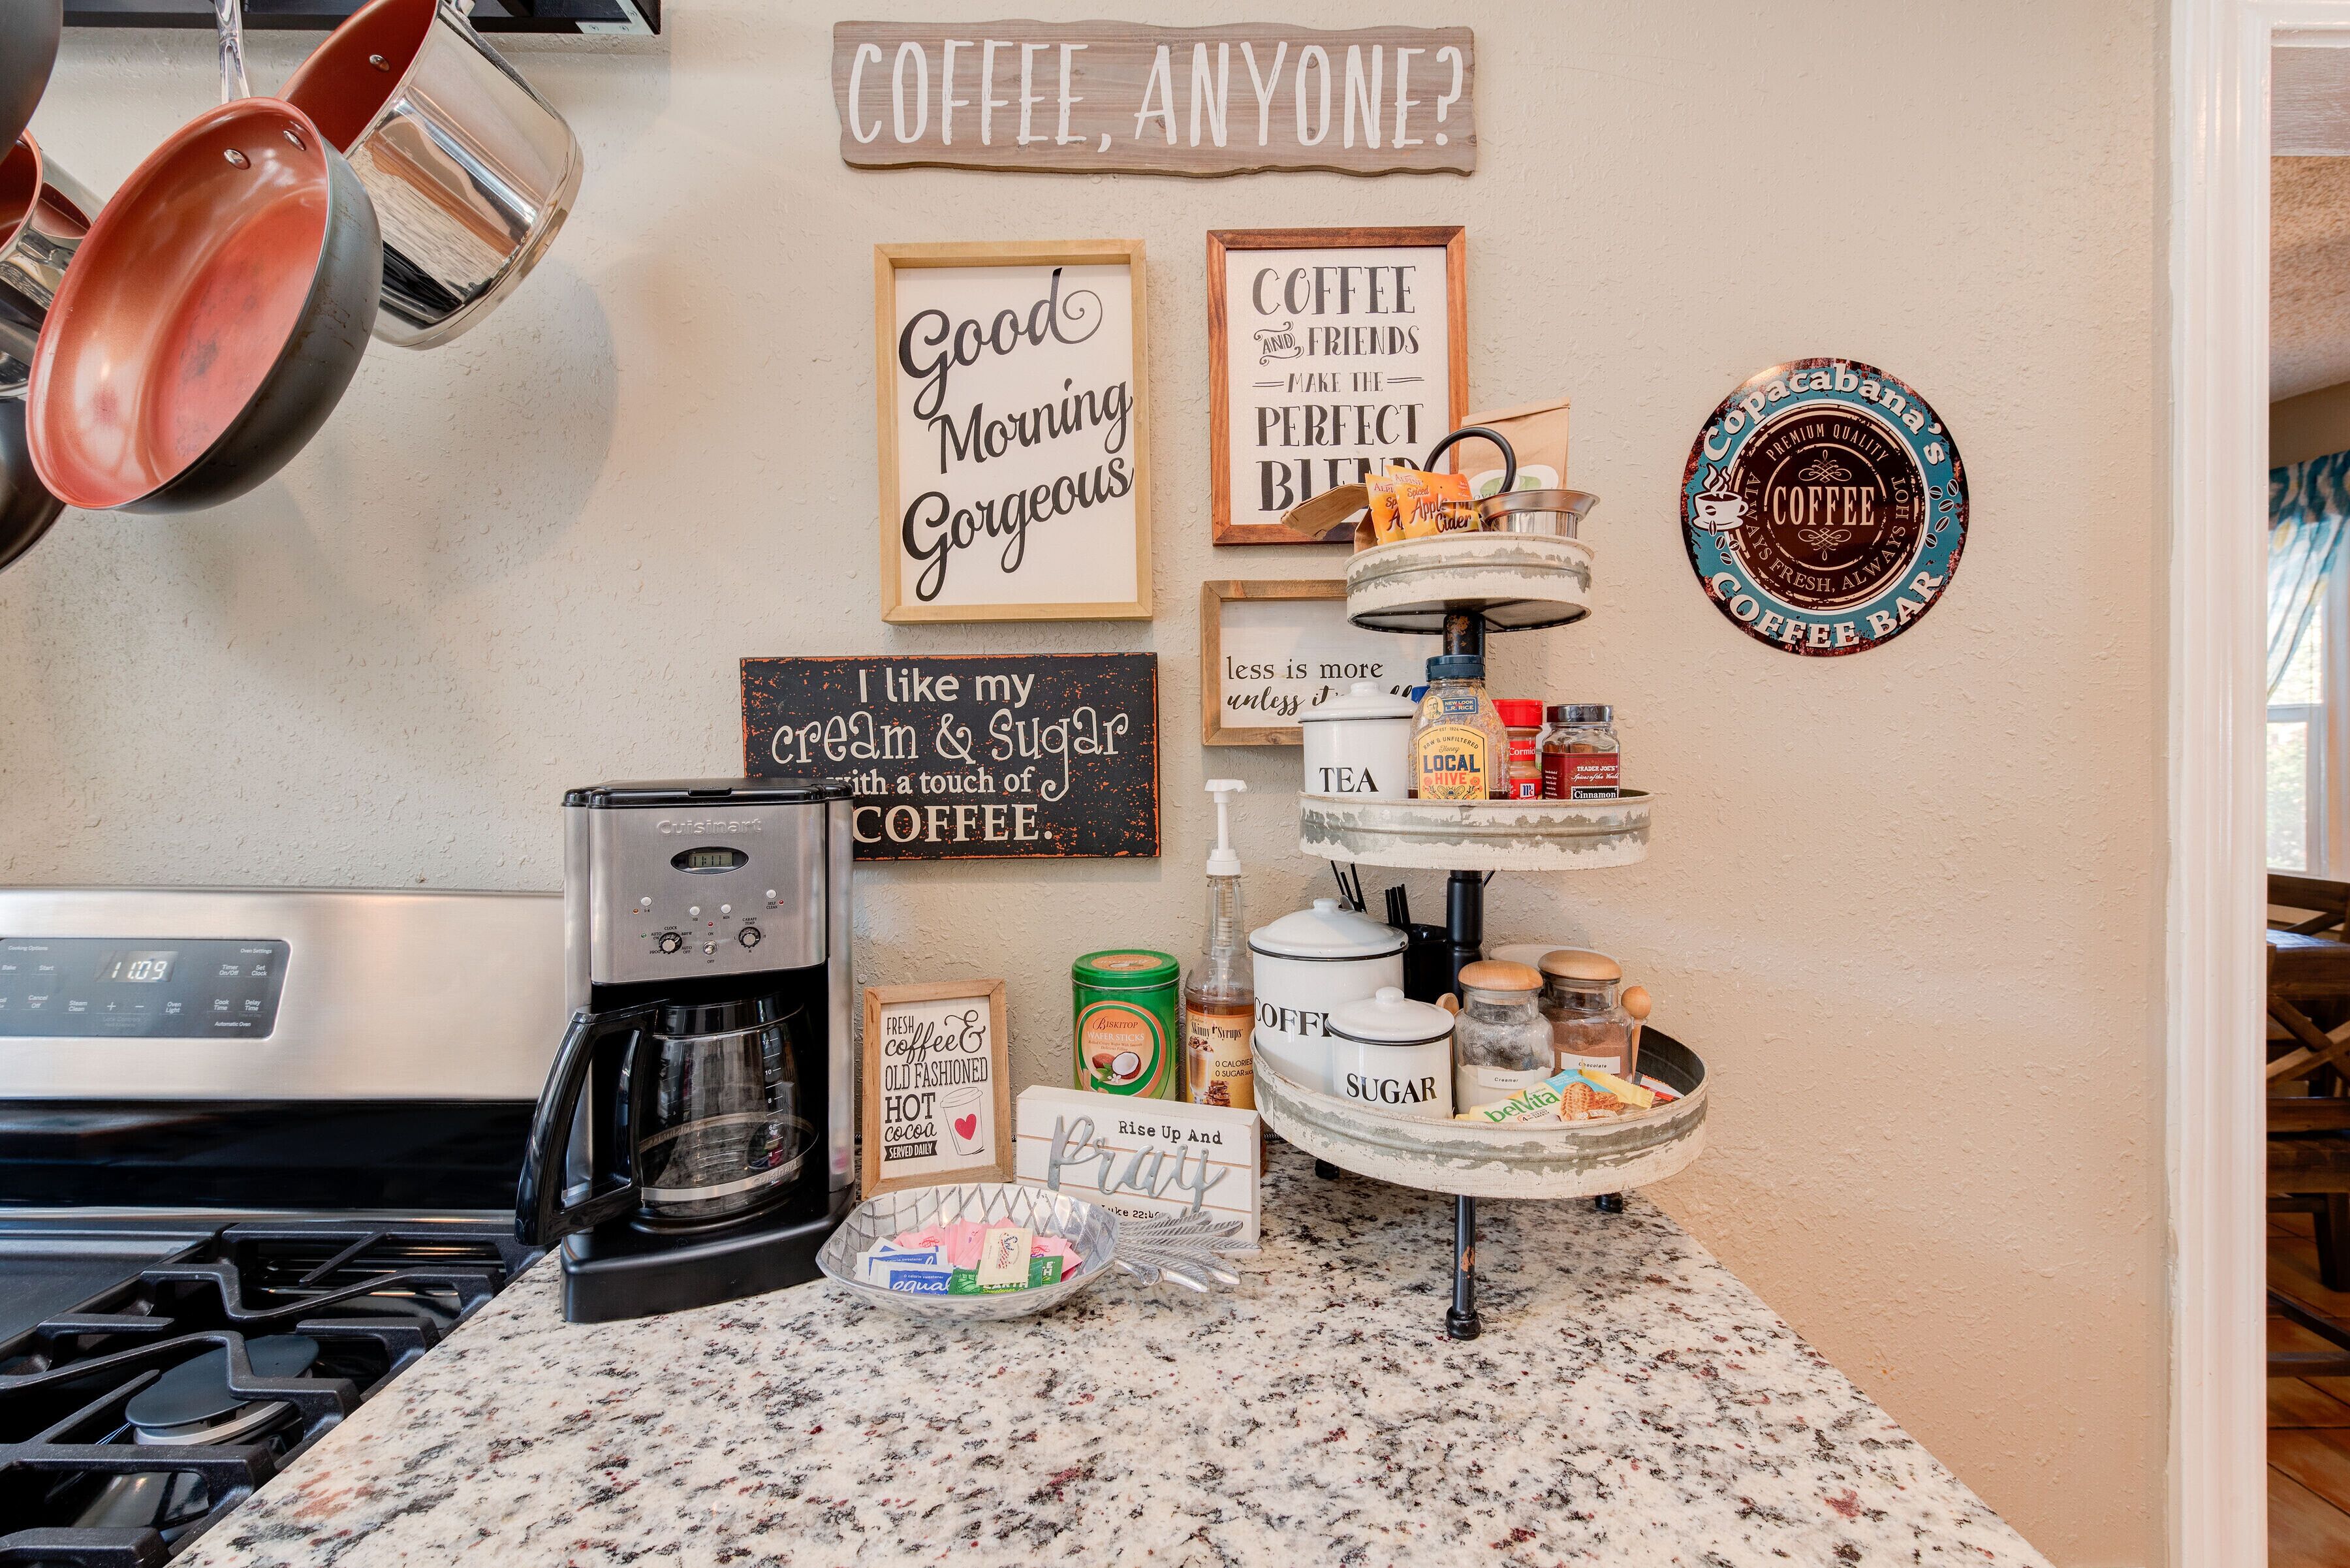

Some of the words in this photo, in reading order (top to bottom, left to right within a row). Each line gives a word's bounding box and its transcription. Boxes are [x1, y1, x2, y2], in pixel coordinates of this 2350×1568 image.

[848, 39, 1112, 153] COFFEE,
[1135, 41, 1463, 148] ANYONE?
[1252, 266, 1416, 315] COFFEE
[899, 267, 1103, 420] Good
[1262, 333, 1296, 354] AND
[1307, 326, 1419, 355] FRIENDS
[1287, 372, 1340, 393] MAKE
[1349, 371, 1383, 392] THE
[928, 378, 1133, 474] Morning
[1255, 403, 1424, 447] PERFECT
[1704, 364, 1945, 465] Copacabana's
[1766, 424, 1825, 461] PREMIUM
[1833, 424, 1889, 462] QUALITY
[1255, 458, 1420, 511] BLE
[1373, 482, 1394, 493] ALPI
[1407, 486, 1429, 499] Spiced
[1773, 486, 1874, 525] COFFEE
[902, 458, 1134, 601] Gorgeous
[1435, 510, 1471, 533] Cider
[1746, 471, 1773, 559] ALWAYS
[1769, 558, 1835, 593] FRESH,
[1842, 525, 1905, 590] ALWAYS
[1891, 477, 1909, 520] HOT
[1712, 572, 1859, 648] COFFEE
[1866, 571, 1943, 638] BAR
[1227, 655, 1274, 680] less
[1286, 659, 1307, 679] is
[1320, 663, 1383, 679] more
[859, 669, 867, 702] I
[887, 668, 959, 702] like
[976, 673, 1035, 708] my
[1227, 686, 1306, 716] unless
[1312, 685, 1345, 706] it'
[772, 711, 918, 764] cream
[935, 713, 976, 764] &
[990, 706, 1129, 802] Sugar
[1423, 739, 1435, 750] RAW
[1443, 736, 1479, 749] UNFILTERED
[1439, 745, 1460, 753] Honey
[1424, 754, 1480, 773] LOCAL
[826, 769, 888, 795] ith
[897, 775, 913, 794] a
[919, 766, 995, 794] touch
[1004, 766, 1035, 792] of
[1319, 767, 1379, 792] TEA
[1435, 772, 1467, 785] HIVE
[657, 818, 762, 836] Cuisinart
[853, 804, 1052, 843] COFFEE.
[887, 1015, 914, 1035] FRESH
[1191, 1022, 1210, 1039] Skinny
[1254, 997, 1332, 1037] COFF
[885, 1022, 958, 1063] coffee
[945, 1009, 986, 1053] &
[1087, 1031, 1114, 1041] WAFER
[1116, 1033, 1144, 1042] STICKS
[1217, 1026, 1243, 1041] Syrups
[885, 1064, 910, 1091] OLD
[914, 1056, 988, 1088] FASHIONED
[1221, 1058, 1253, 1067] CALORIES
[1347, 1073, 1437, 1104] SUGAR
[885, 1092, 935, 1123] HOT
[1484, 1090, 1561, 1122] belVita
[885, 1122, 937, 1142] cocoa
[1118, 1120, 1155, 1137] Rise
[1161, 1125, 1182, 1144] Up
[1189, 1130, 1223, 1145] And
[889, 1146, 913, 1159] SERVED
[915, 1142, 933, 1157] DAILY
[752, 1160, 798, 1185] Cuisinart
[1047, 1114, 1227, 1218] Pray
[1101, 1205, 1129, 1216] uke
[893, 1276, 952, 1293] equal
